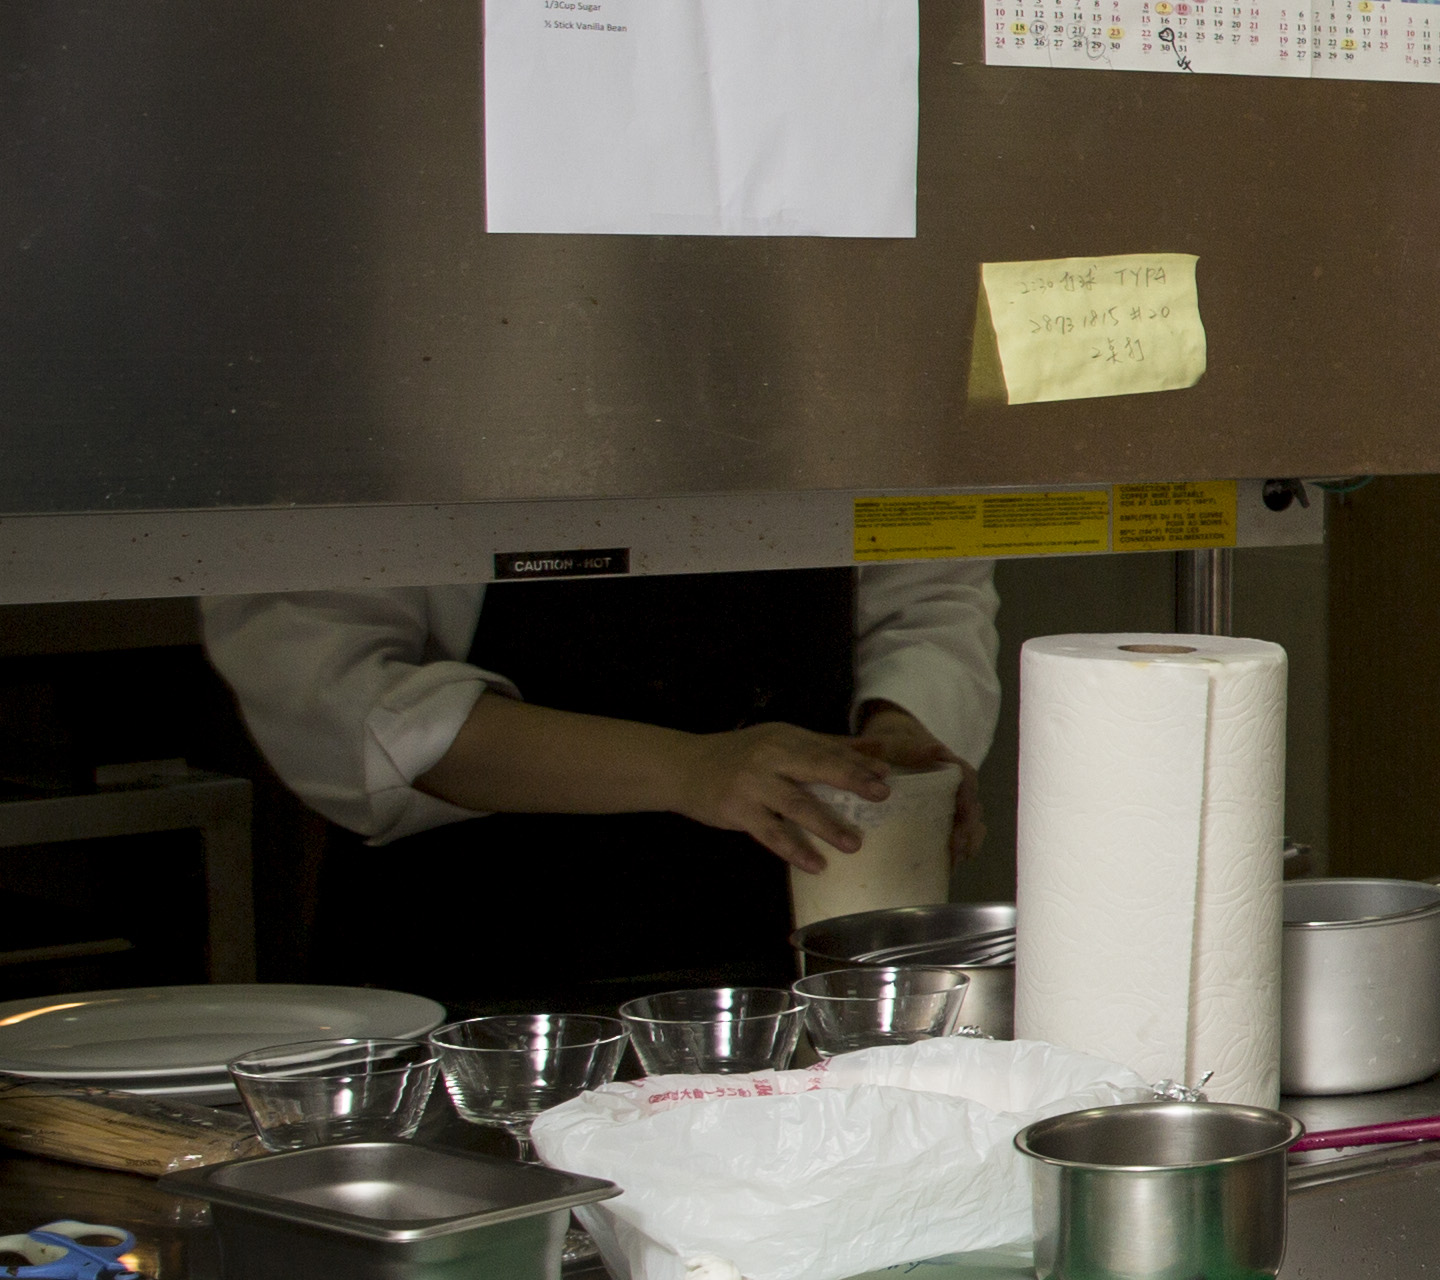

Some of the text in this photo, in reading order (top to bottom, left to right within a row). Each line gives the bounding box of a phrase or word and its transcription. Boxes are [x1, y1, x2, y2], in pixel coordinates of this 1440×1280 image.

[544, 0, 601, 12] 1/3Cup Sugar
[554, 21, 574, 29] Stick
[576, 22, 604, 31] Vanilla
[606, 24, 627, 32] Bean
[514, 558, 574, 572] CAUTION
